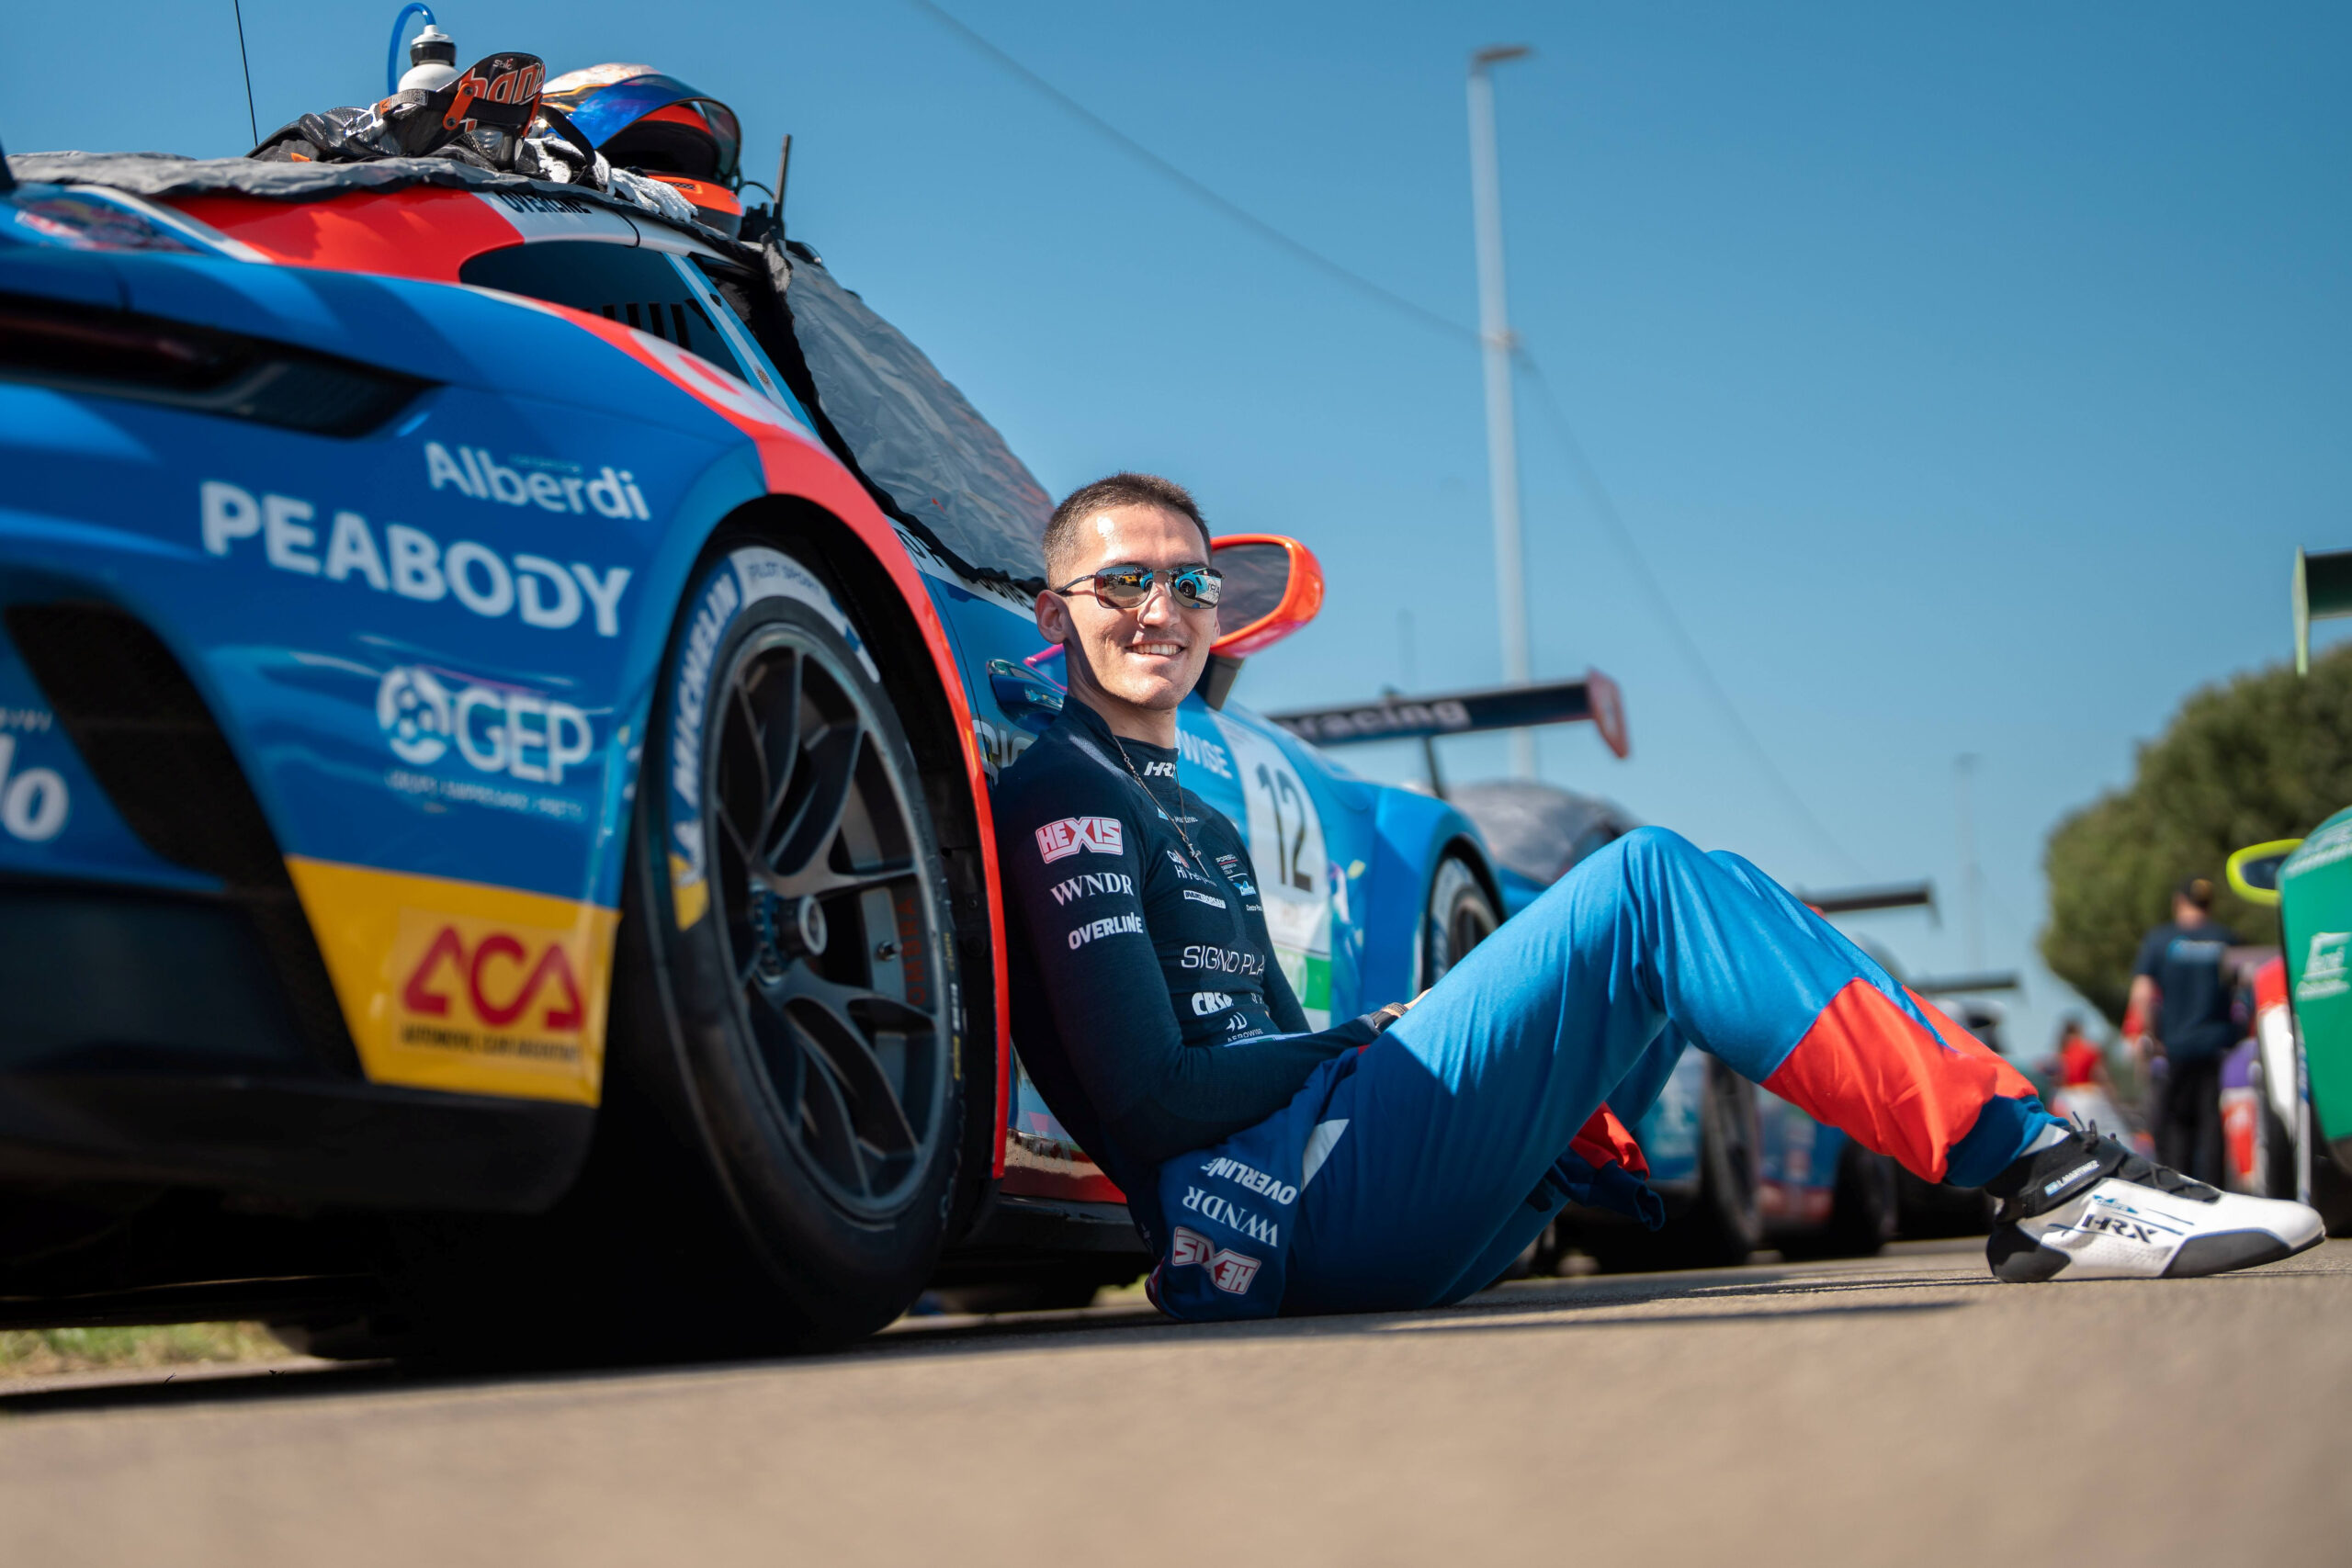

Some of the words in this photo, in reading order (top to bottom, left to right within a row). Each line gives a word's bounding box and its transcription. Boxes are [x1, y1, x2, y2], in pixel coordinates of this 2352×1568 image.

[424, 441, 651, 521] Alberdi
[199, 479, 632, 638] PEABODY
[673, 571, 739, 808] MICHELIN
[455, 684, 594, 785] GEP
[1036, 817, 1124, 860] HEXIS
[1255, 762, 1314, 894] 12
[1049, 872, 1135, 907] WNDR
[1067, 911, 1144, 951] OVERLINE
[1181, 944, 1240, 974] SIGNO
[401, 923, 587, 1034] ACA
[1201, 1156, 1298, 1205] OVERLINE
[1182, 1185, 1279, 1248] WNDR
[2081, 1213, 2159, 1244] HRX
[1172, 1227, 1261, 1294] HEXIS
